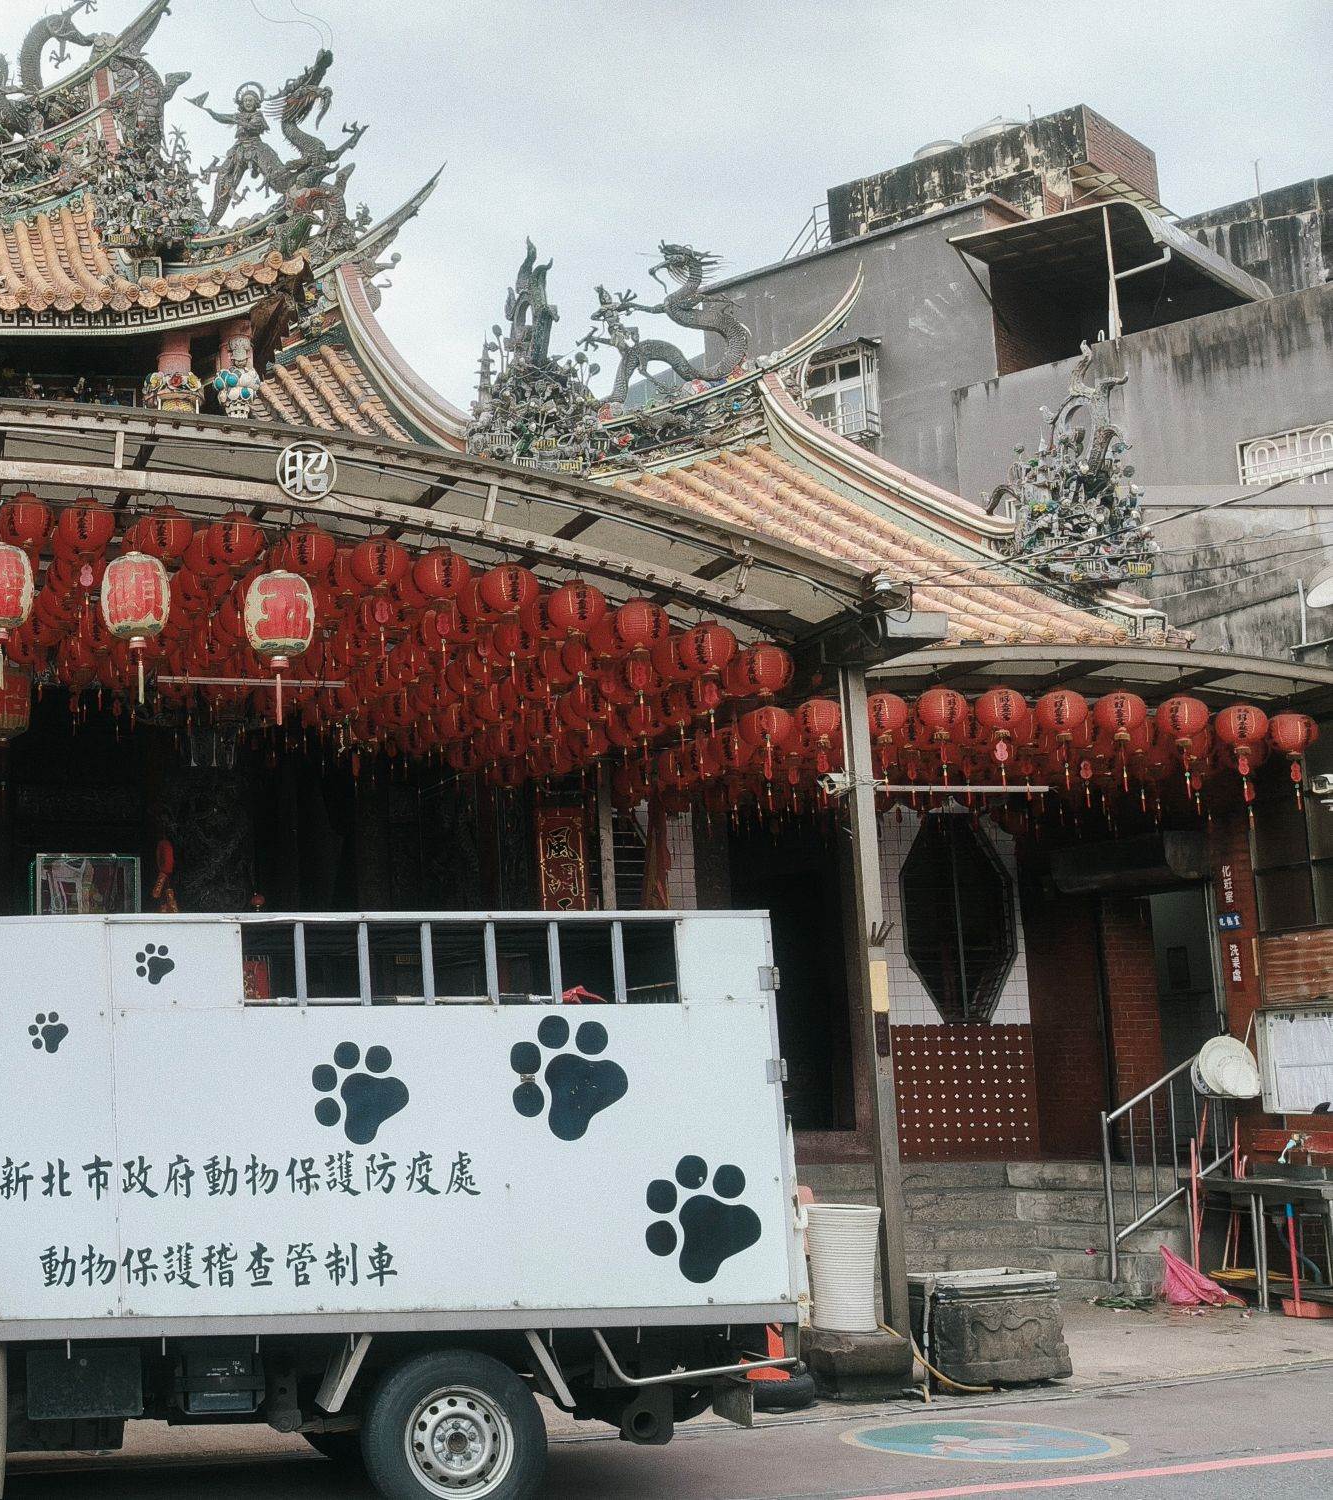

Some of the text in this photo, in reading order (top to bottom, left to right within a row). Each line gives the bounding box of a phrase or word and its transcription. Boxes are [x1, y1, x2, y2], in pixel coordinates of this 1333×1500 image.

[283, 447, 329, 497] 昭
[255, 577, 312, 641] 五
[546, 826, 580, 910] 風調
[39, 1241, 399, 1289] 動物保護稽查管制車
